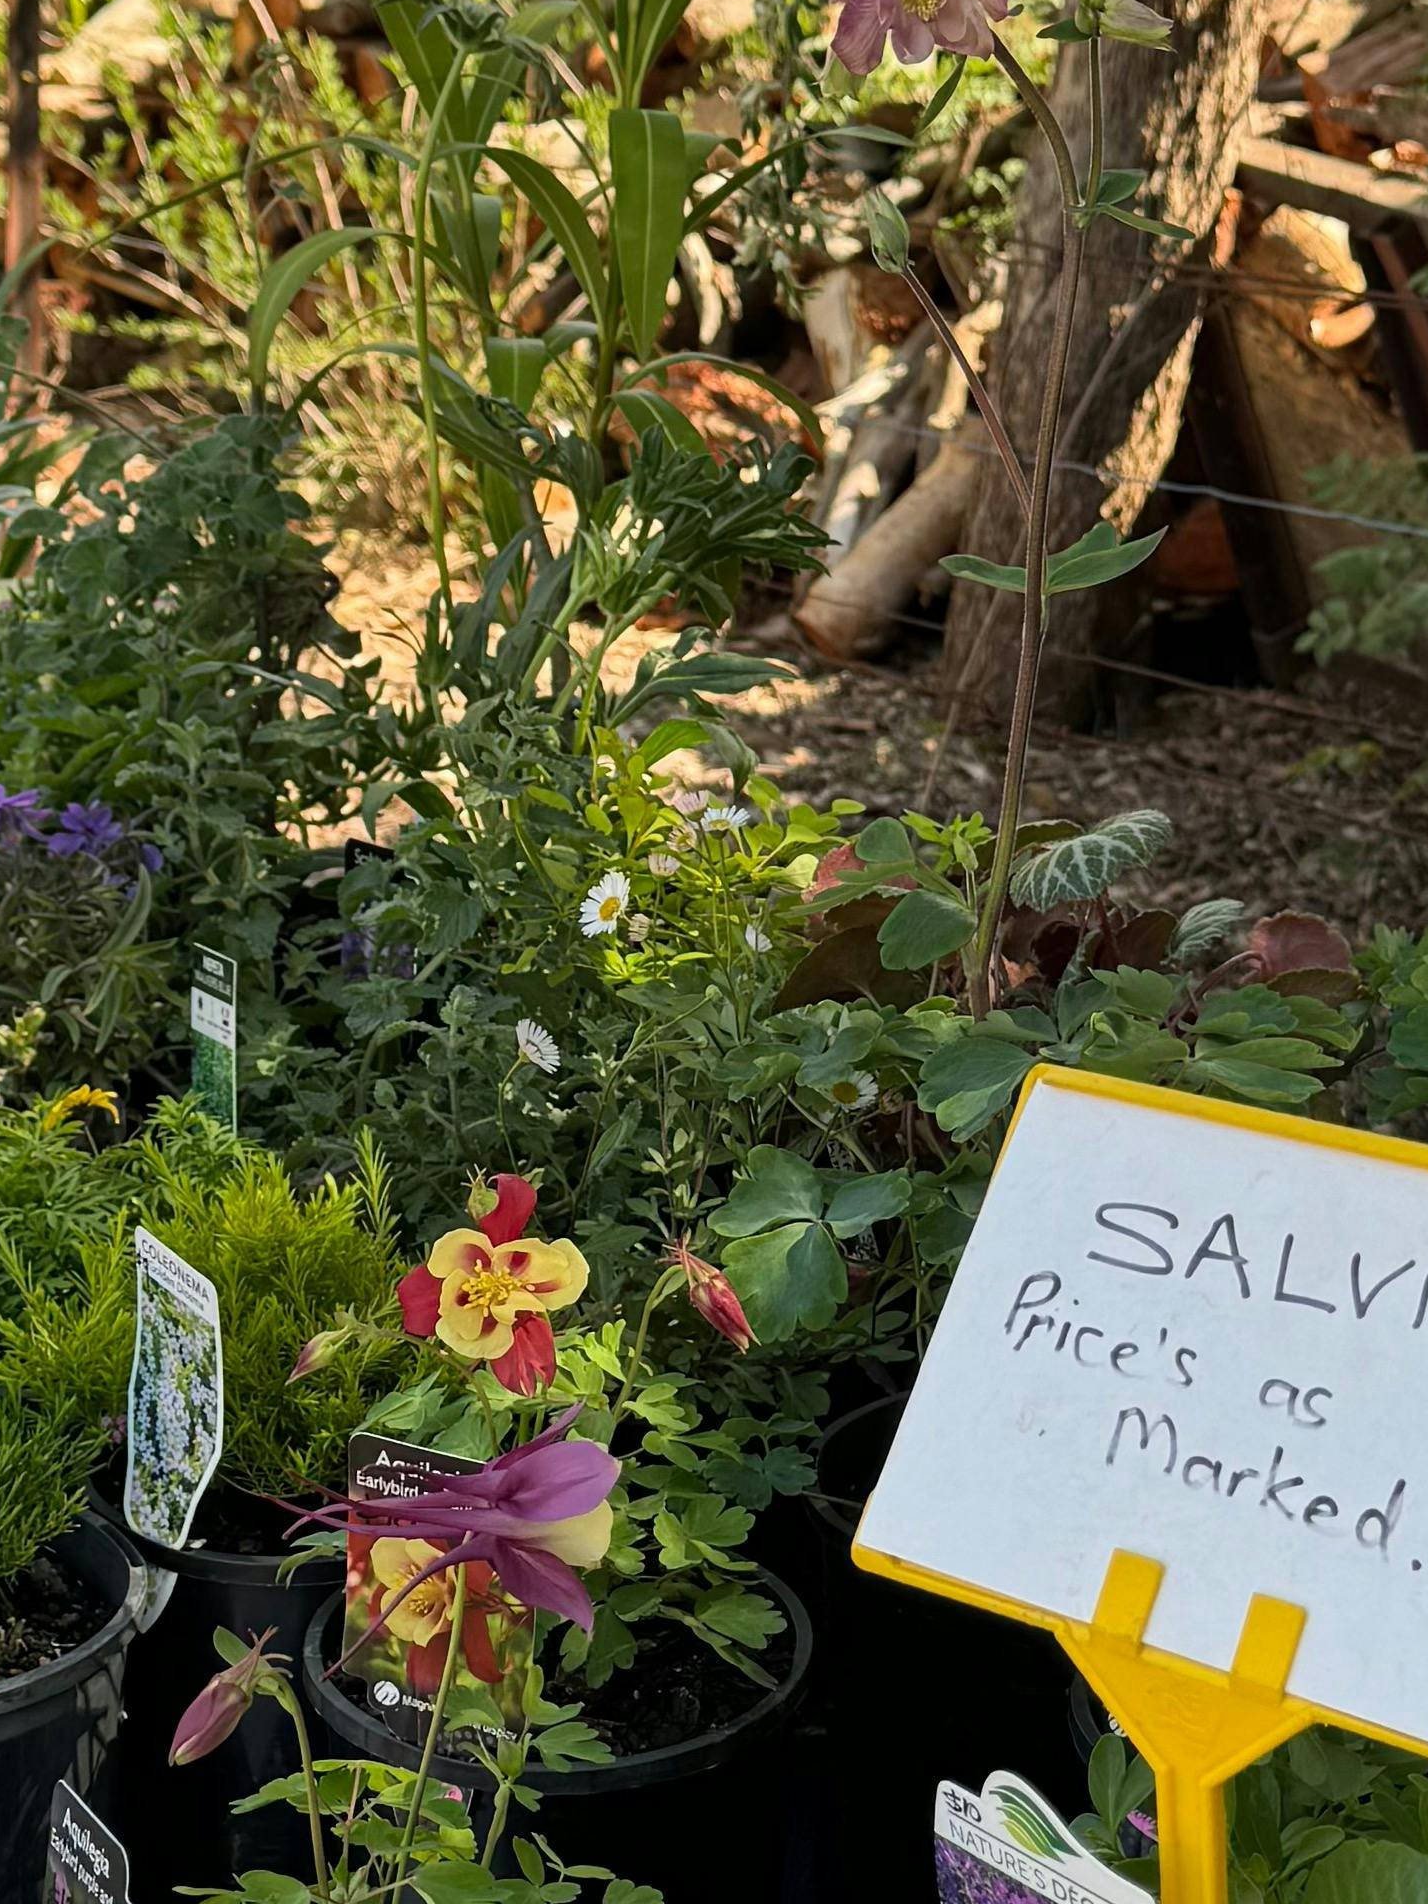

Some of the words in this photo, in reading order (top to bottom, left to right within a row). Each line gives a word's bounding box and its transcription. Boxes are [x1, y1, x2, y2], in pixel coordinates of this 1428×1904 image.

[141, 1238, 210, 1303] COLEONEMA
[1002, 1270, 1199, 1389] Price's
[1258, 1373, 1334, 1429] as
[61, 1806, 110, 1879] Aquilegia
[948, 1816, 1047, 1892] NATURE'S
